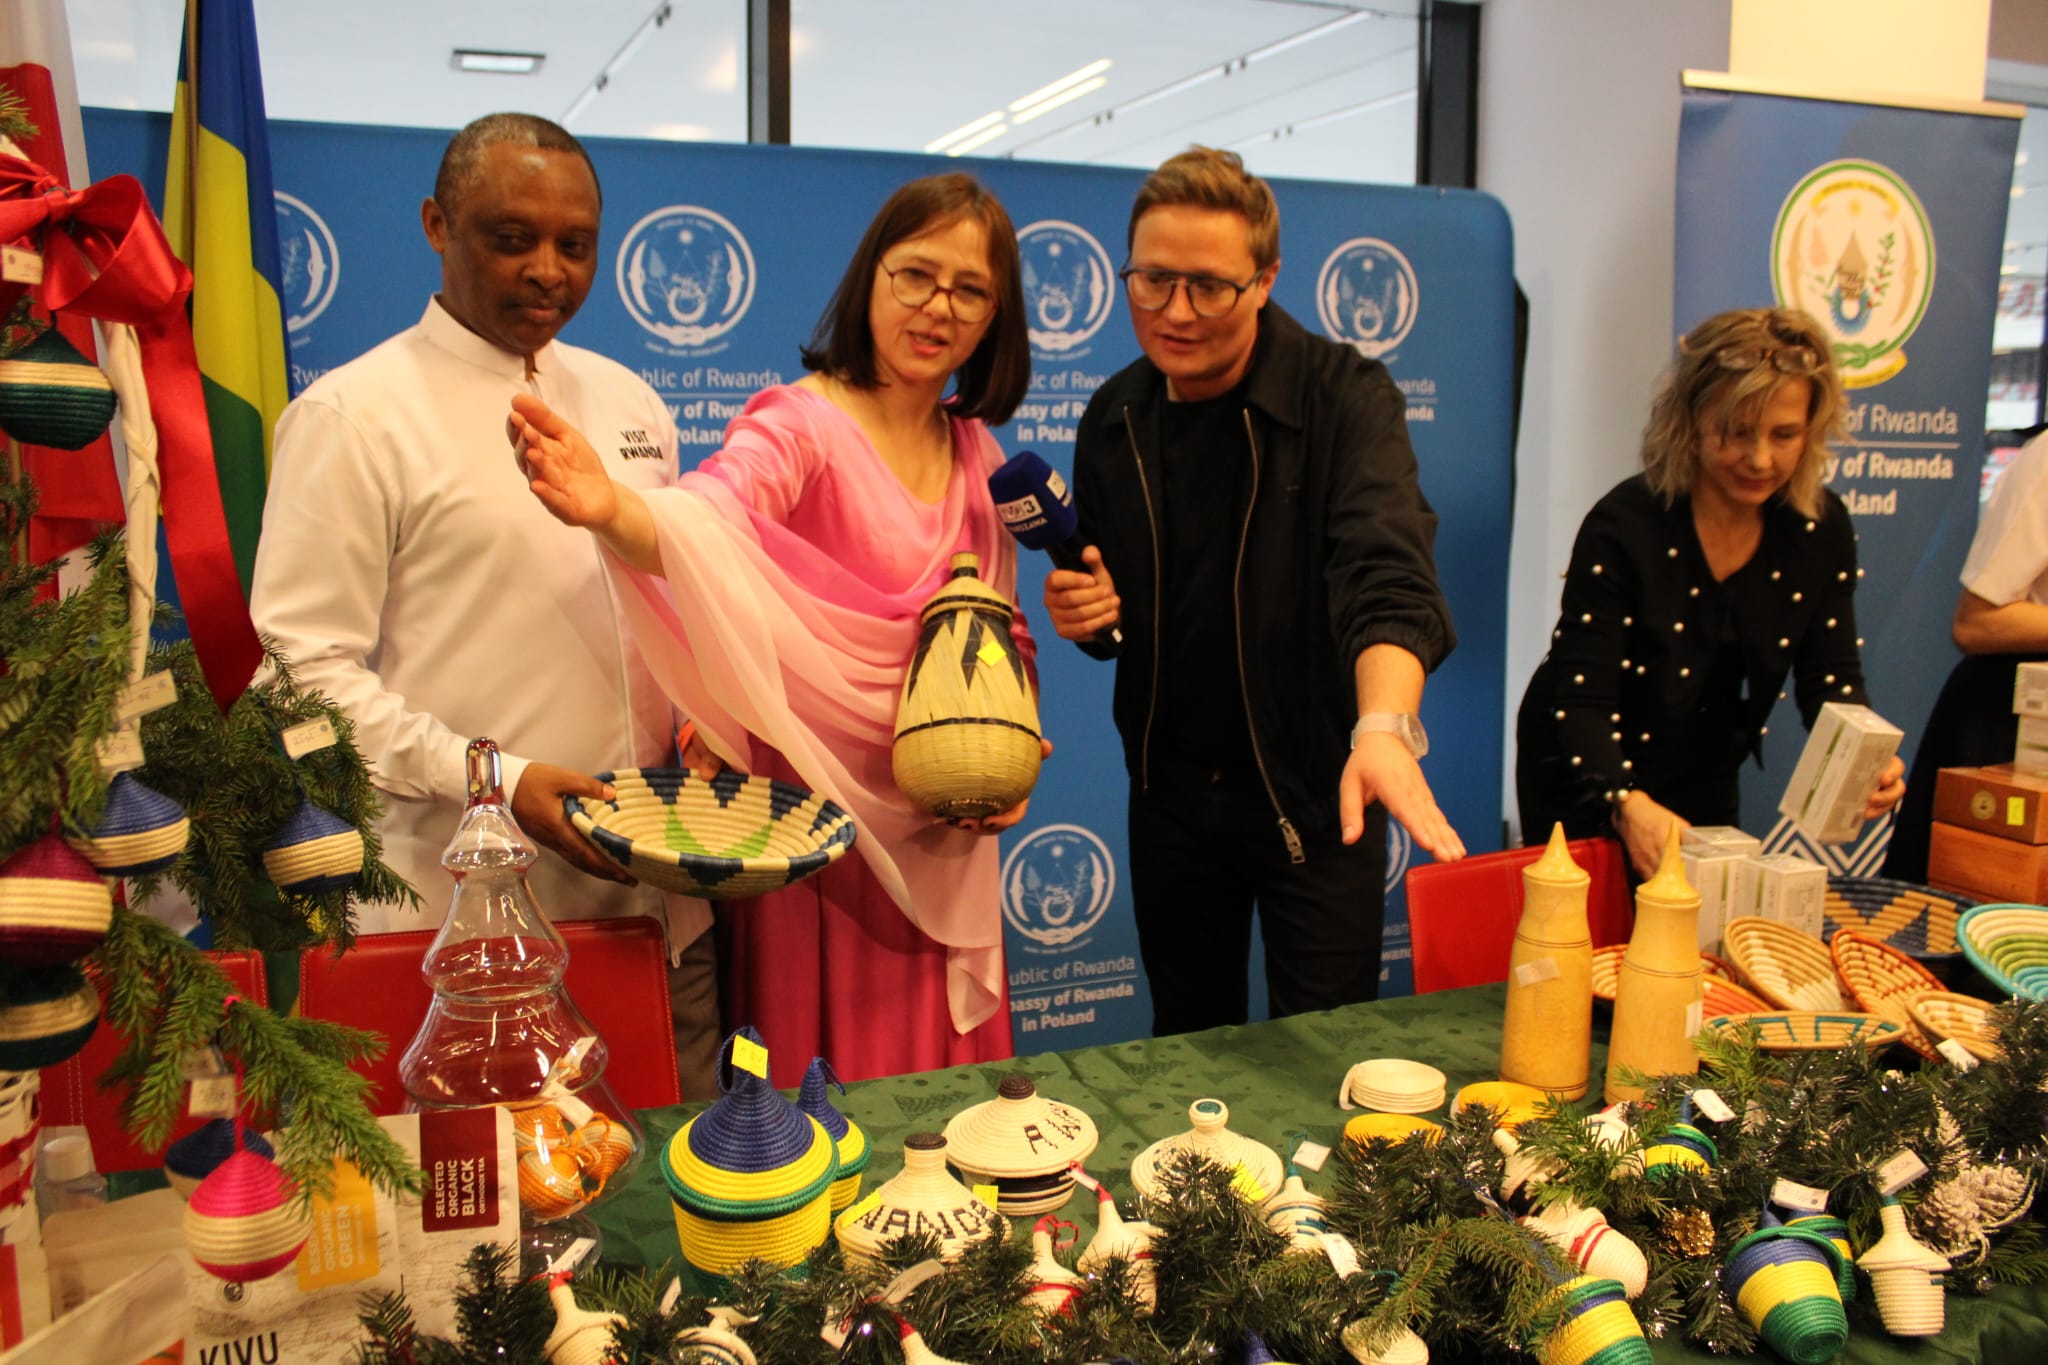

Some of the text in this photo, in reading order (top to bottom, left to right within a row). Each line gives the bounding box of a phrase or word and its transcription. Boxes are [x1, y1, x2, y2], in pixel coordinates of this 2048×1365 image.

[682, 367, 703, 388] of
[706, 367, 782, 389] Rwanda
[1049, 370, 1069, 390] of
[683, 400, 705, 419] of
[1051, 400, 1070, 419] of
[1870, 403, 1958, 435] Rwanda
[1017, 423, 1078, 443] in Pola
[619, 446, 664, 461] RWANDA
[1842, 451, 1868, 479] of
[1868, 451, 1954, 480] Rwanda
[1841, 488, 1898, 516] land
[1009, 955, 1137, 986] ublic of Rwanda
[1054, 989, 1072, 1007] of
[1073, 983, 1135, 1004] Rwanda
[1022, 1008, 1096, 1033] in Poland
[434, 1160, 446, 1219] SELECTED
[447, 1159, 459, 1218] ORGANIC
[461, 1158, 476, 1217] BLACK
[336, 1204, 353, 1269] GREEN
